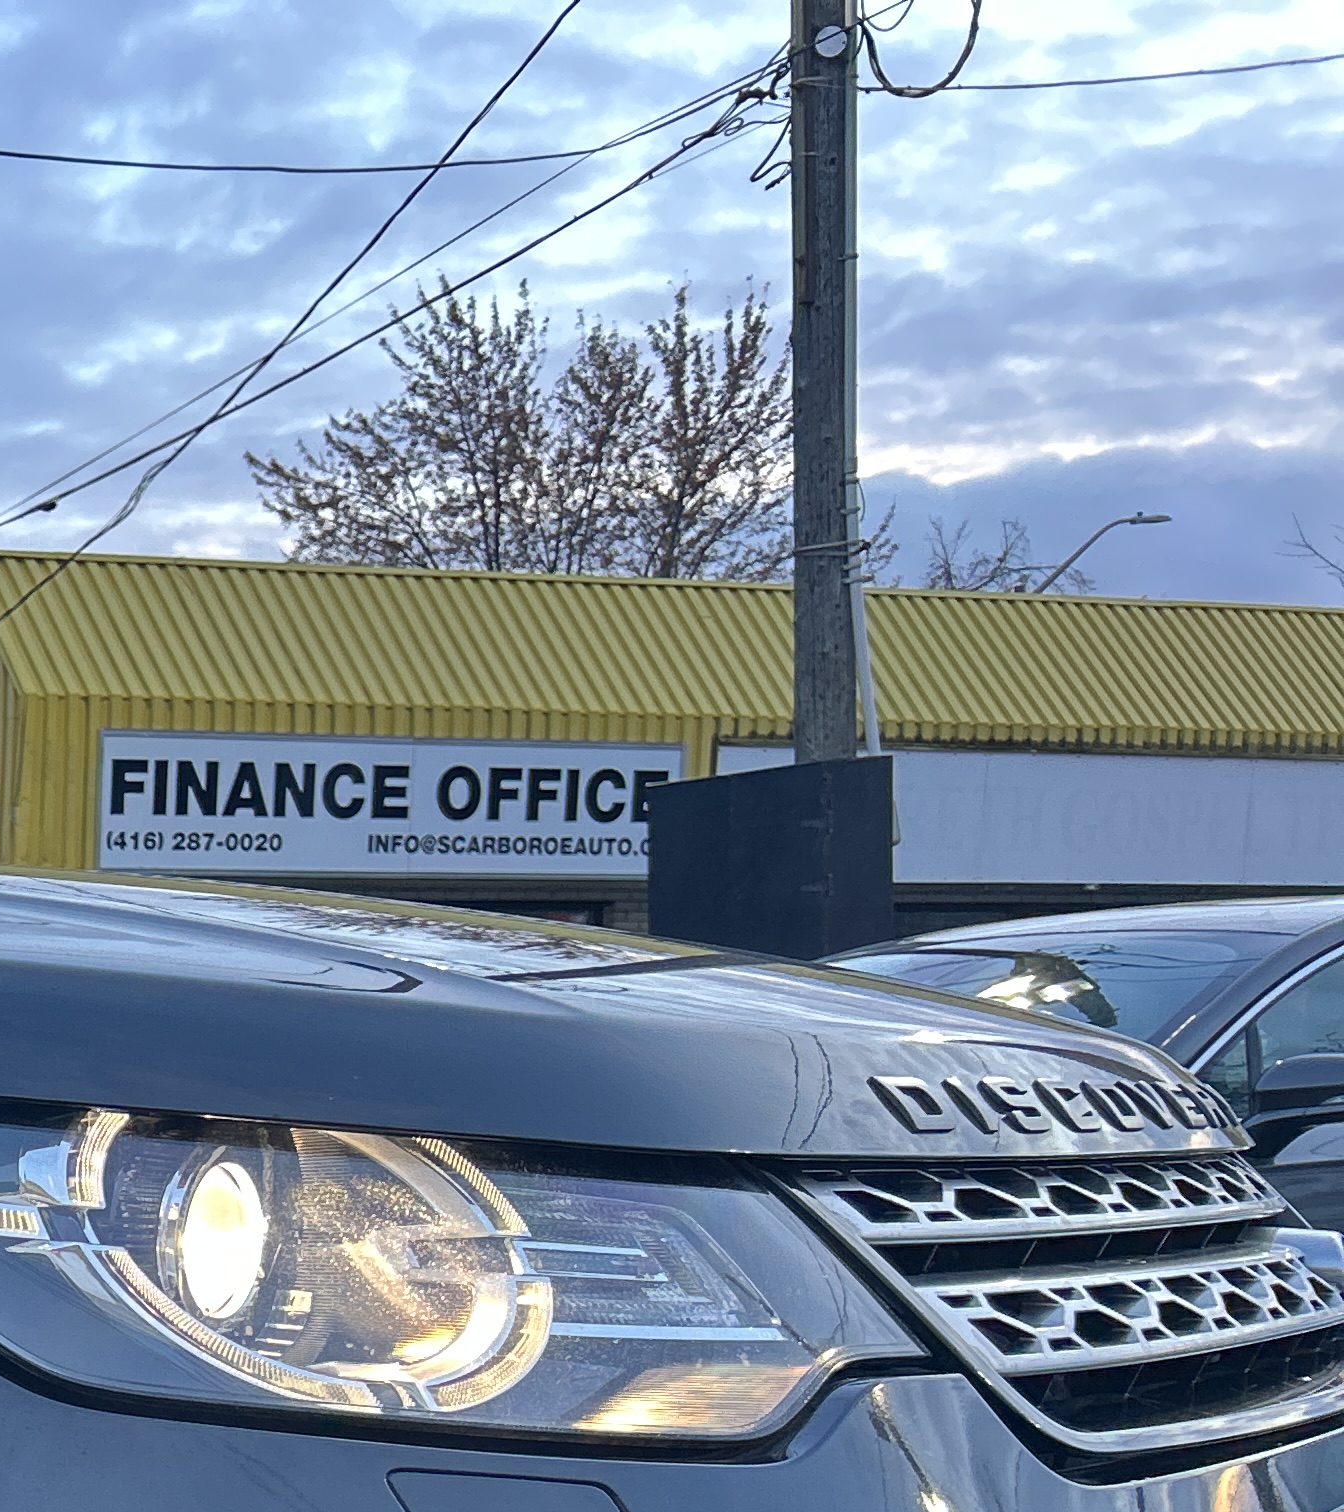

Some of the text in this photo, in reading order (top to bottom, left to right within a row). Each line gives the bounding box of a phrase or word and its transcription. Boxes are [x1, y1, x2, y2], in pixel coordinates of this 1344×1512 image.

[110, 758, 410, 819] FINANCE
[106, 830, 284, 852] (416) 287-0020
